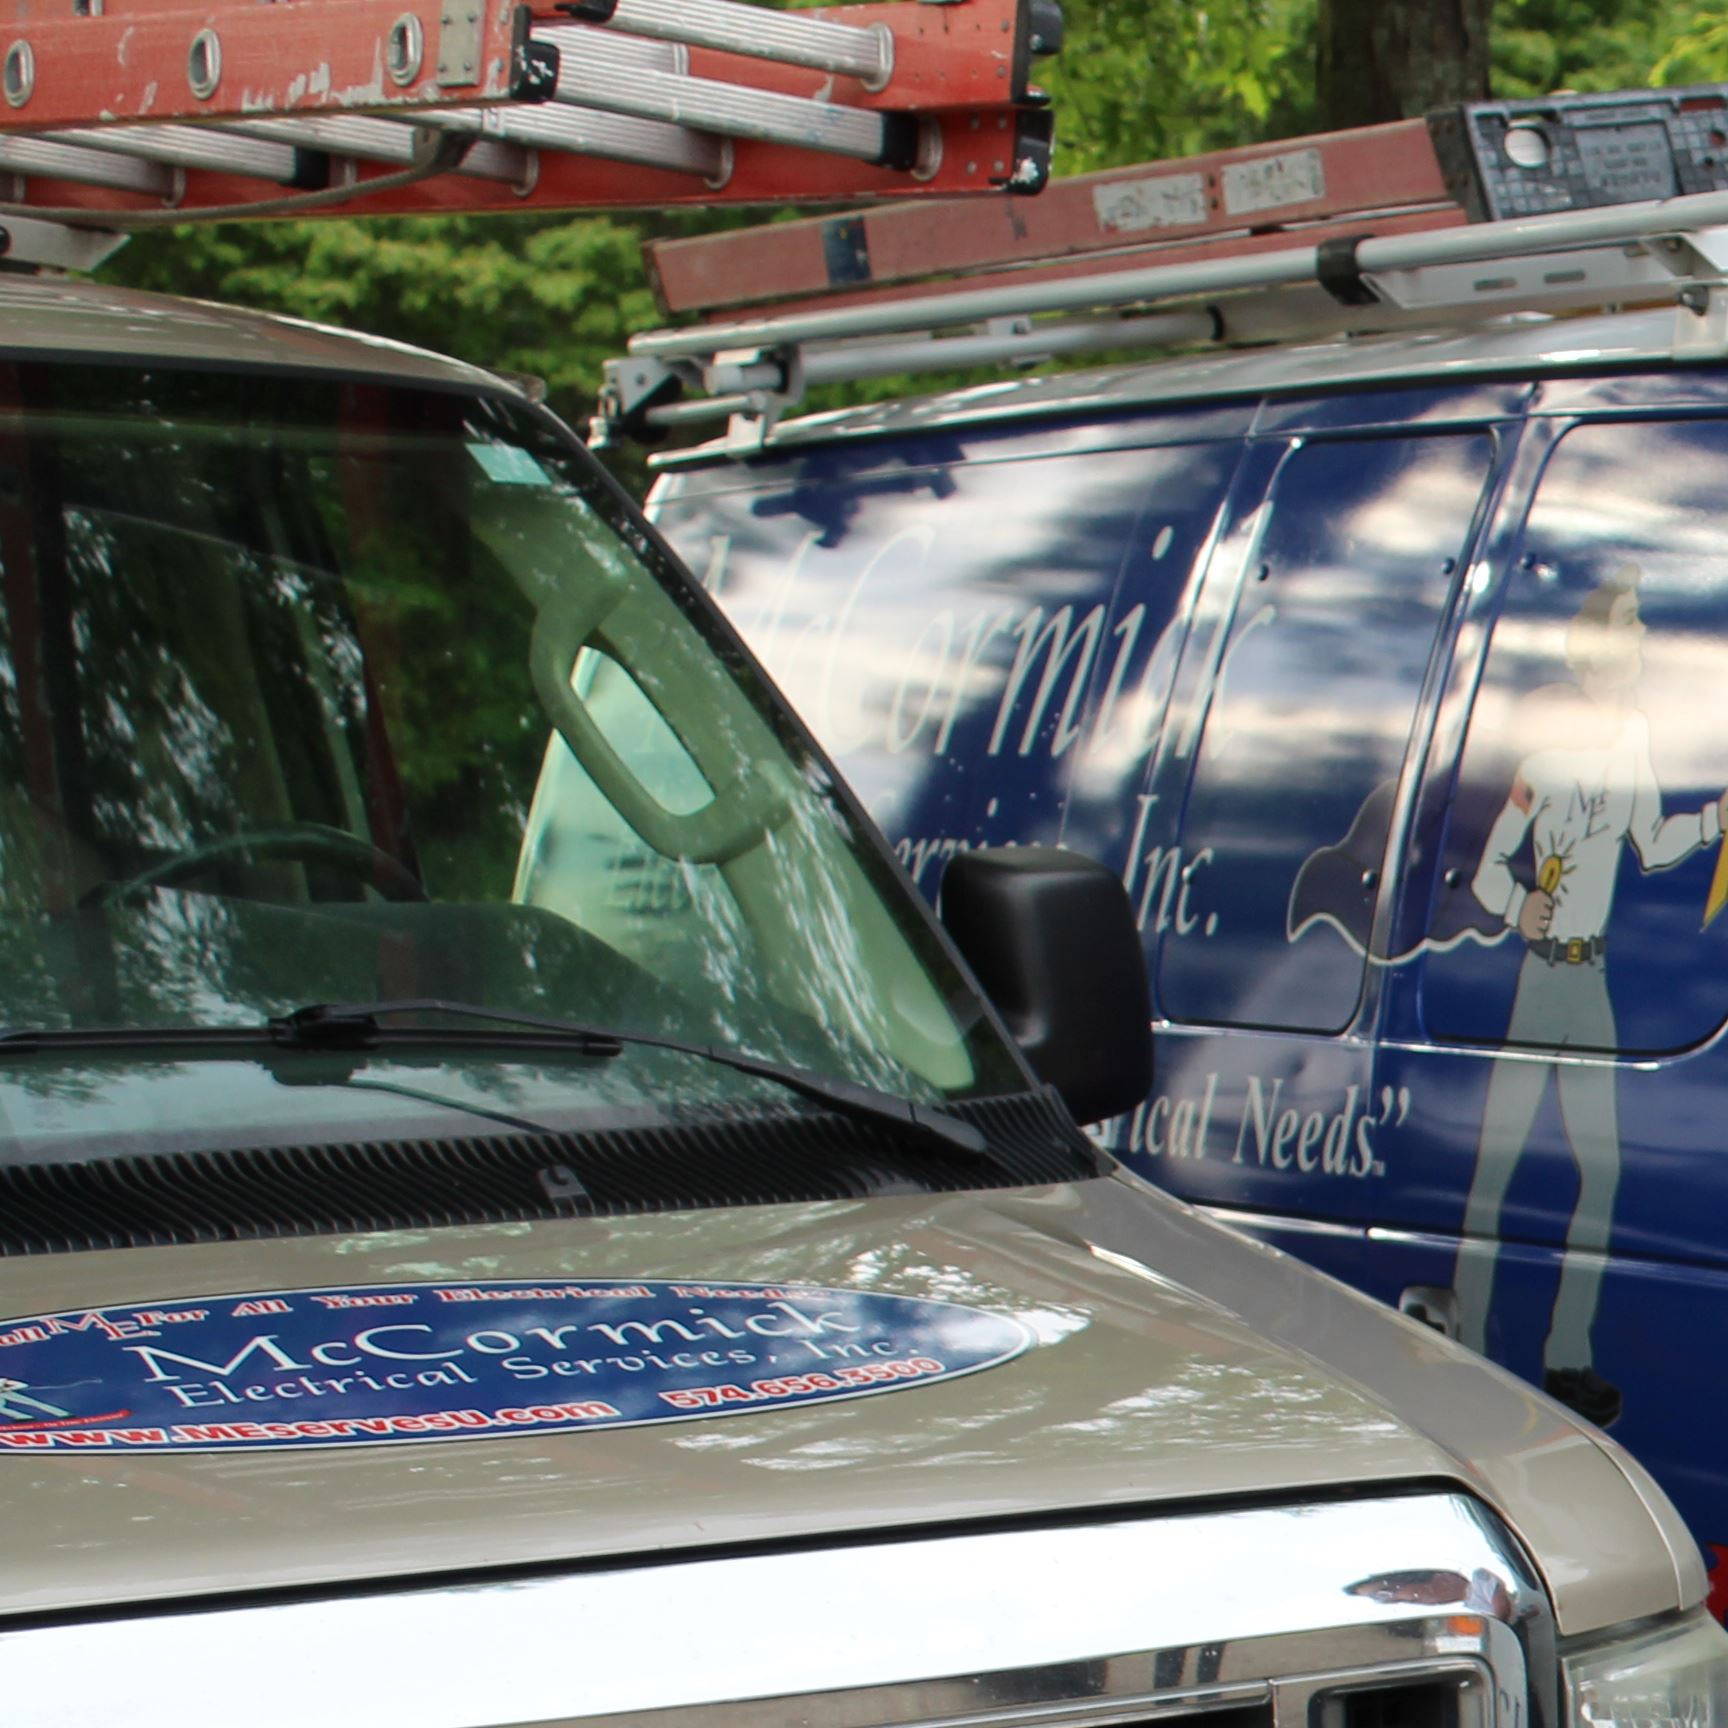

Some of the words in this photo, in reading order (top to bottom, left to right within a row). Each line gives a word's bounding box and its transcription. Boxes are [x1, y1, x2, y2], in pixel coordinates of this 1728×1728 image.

[132, 1309, 210, 1327] For
[231, 1299, 293, 1317] All
[310, 1293, 418, 1309] Your
[433, 1285, 656, 1303] Electrical
[122, 1302, 861, 1382] McCormick
[162, 1362, 478, 1408] Electrical
[501, 1350, 777, 1380] Services,
[800, 1339, 918, 1359] Inc.
[660, 1357, 946, 1408] 574.656.3500
